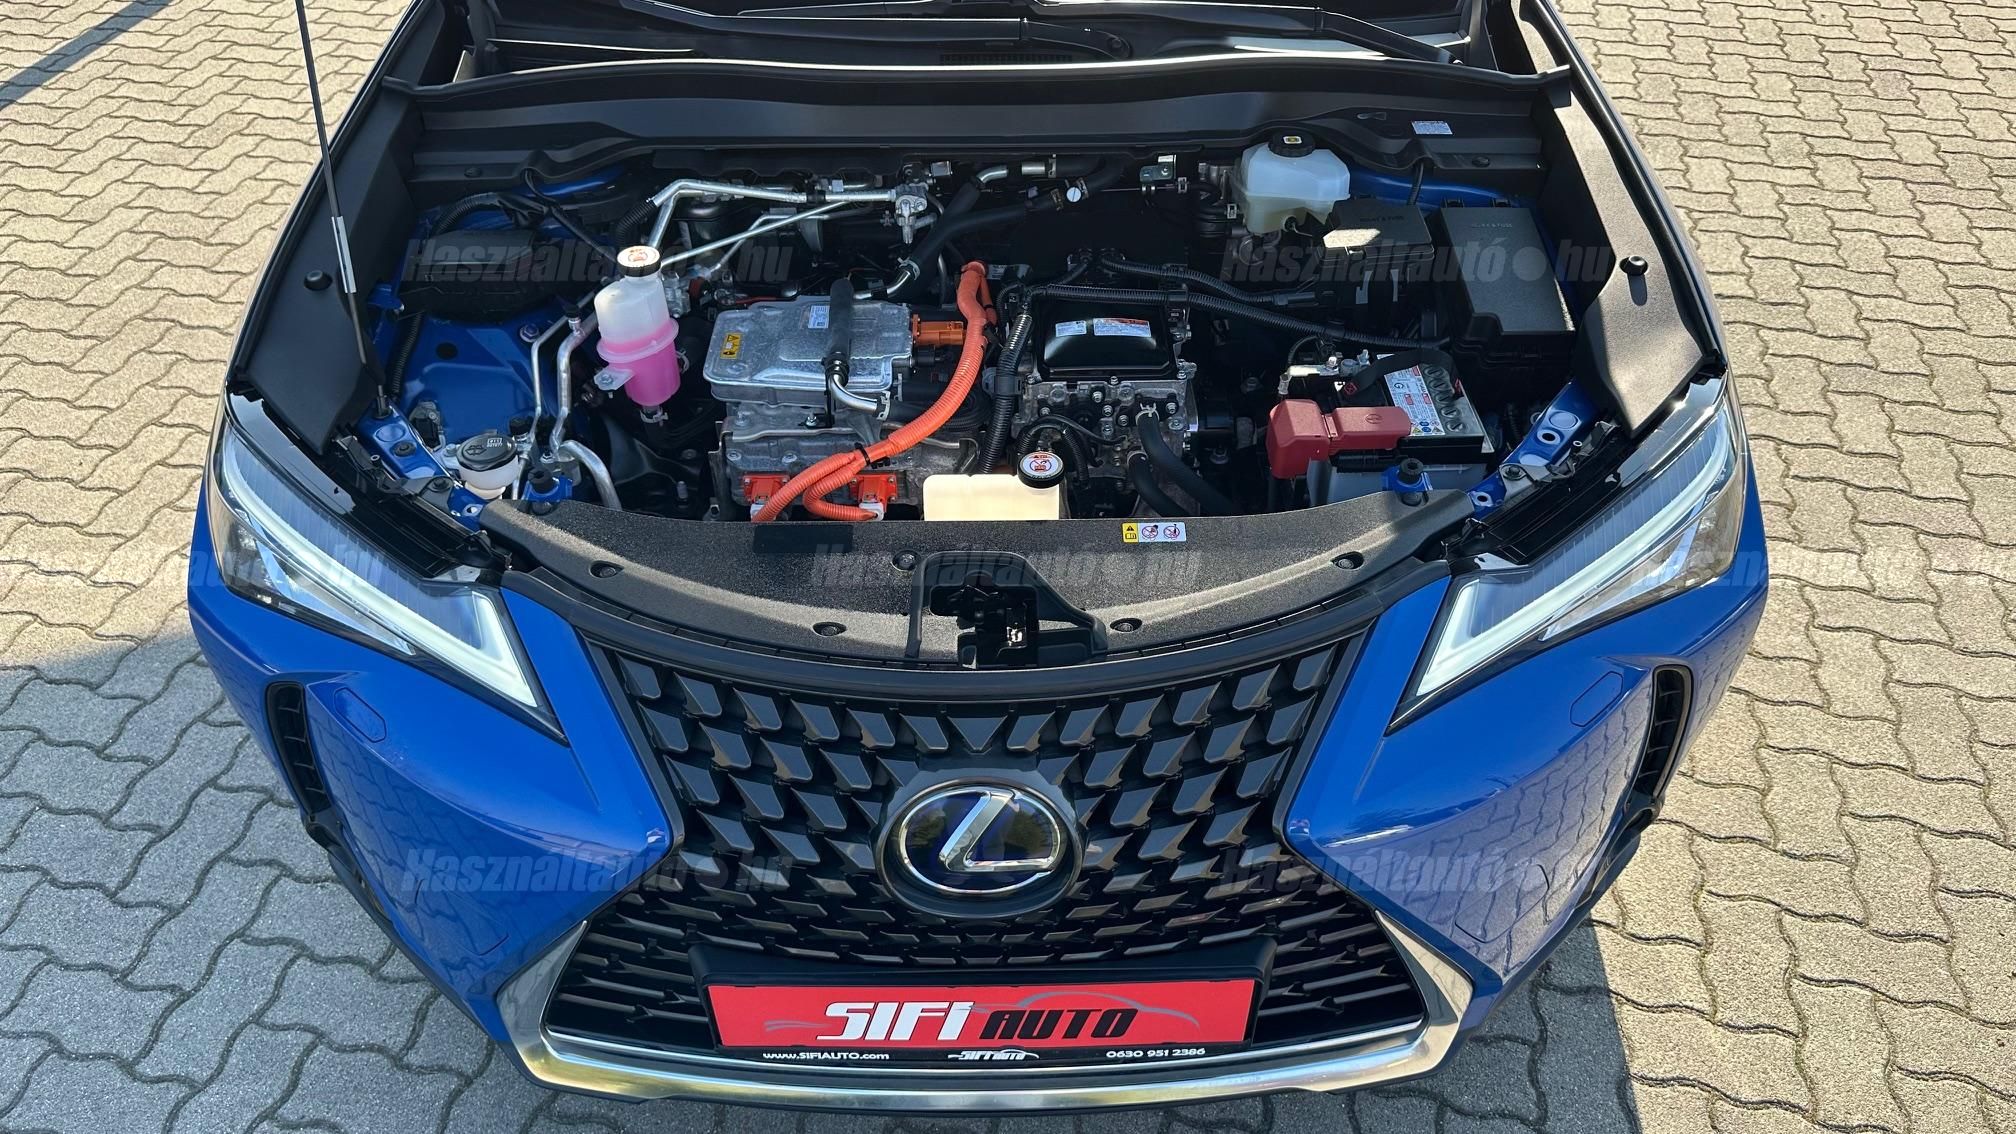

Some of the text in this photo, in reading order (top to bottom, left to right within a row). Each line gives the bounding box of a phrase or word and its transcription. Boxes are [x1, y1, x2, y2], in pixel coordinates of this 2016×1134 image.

[816, 1001, 1138, 1040] SIFI AUTO
[762, 1052, 890, 1060] www.SIFIAUTO.com
[1106, 1047, 1206, 1058] 0630 951 2386
